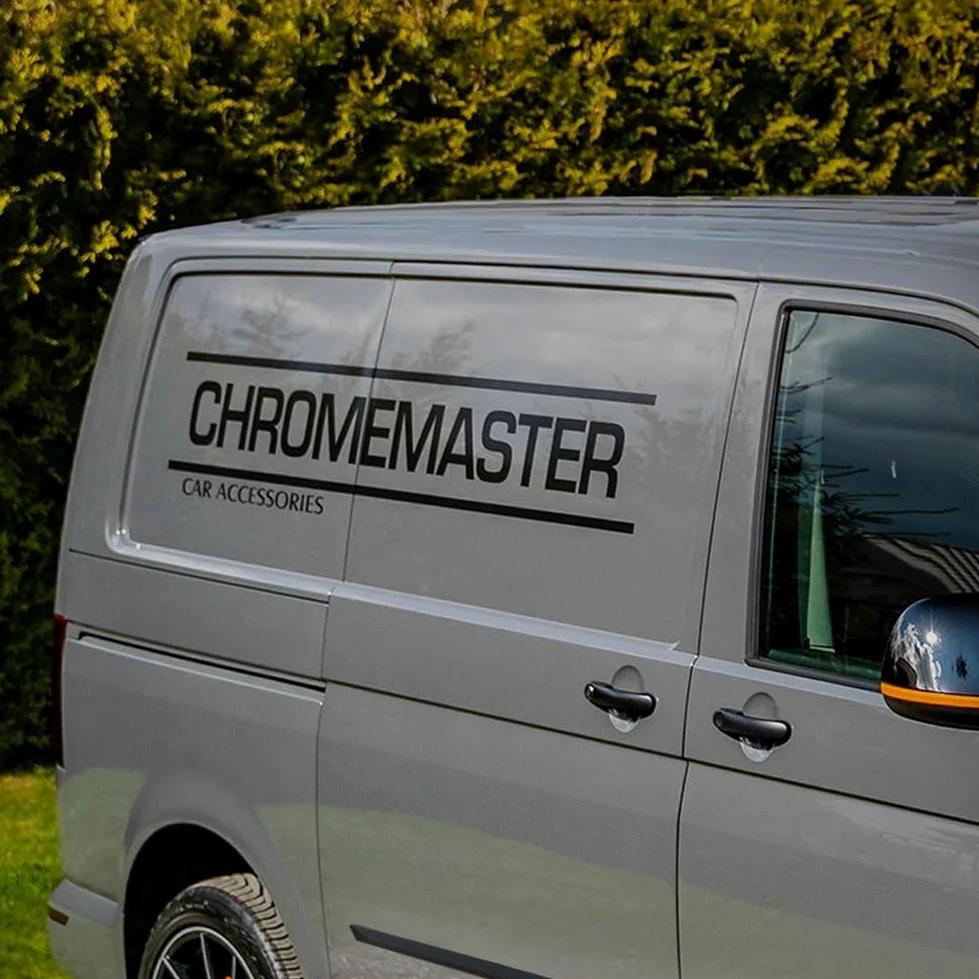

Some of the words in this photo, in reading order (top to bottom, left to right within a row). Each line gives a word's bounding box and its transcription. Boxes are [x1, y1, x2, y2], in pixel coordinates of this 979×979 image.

[188, 381, 626, 499] CHROMEMASTER
[182, 478, 212, 498] CAR
[216, 483, 324, 515] ACCESSORIES
